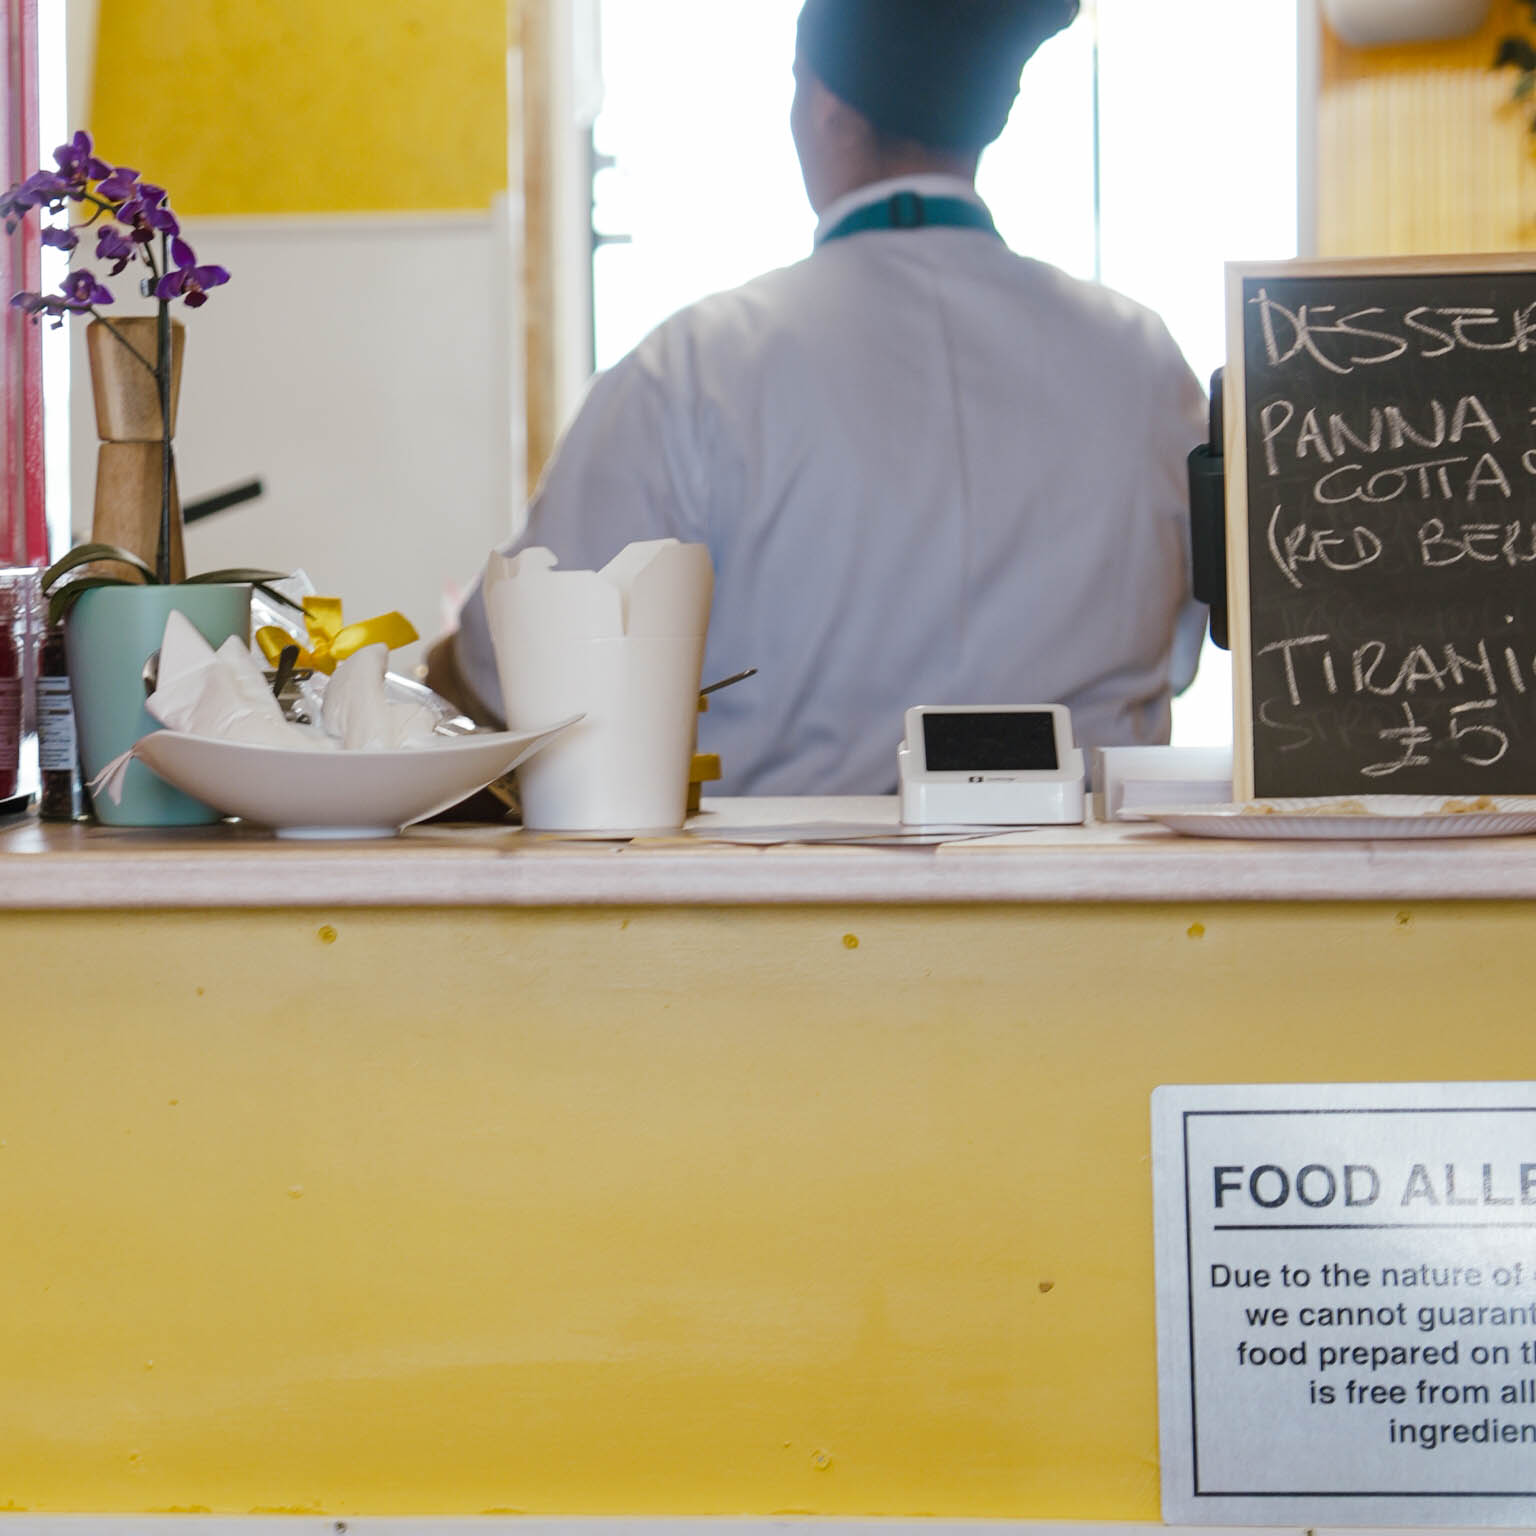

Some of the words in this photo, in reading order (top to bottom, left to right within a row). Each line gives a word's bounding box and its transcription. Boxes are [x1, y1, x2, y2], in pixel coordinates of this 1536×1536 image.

[1259, 395, 1501, 477] PANNA
[1360, 698, 1510, 778] £5
[1213, 1164, 1381, 1208] FOOD
[1210, 1263, 1271, 1289] Due
[1281, 1264, 1311, 1289] to
[1321, 1262, 1370, 1288] the
[1381, 1263, 1483, 1288] nature
[1491, 1261, 1524, 1288] of
[1245, 1306, 1290, 1328] we
[1299, 1302, 1408, 1327] cannot
[1237, 1339, 1307, 1367] food
[1319, 1339, 1459, 1372] prepared
[1471, 1344, 1510, 1366] on
[1309, 1379, 1336, 1405] is
[1345, 1378, 1407, 1405] free
[1416, 1378, 1489, 1405] from
[1389, 1417, 1536, 1450] ingredien
